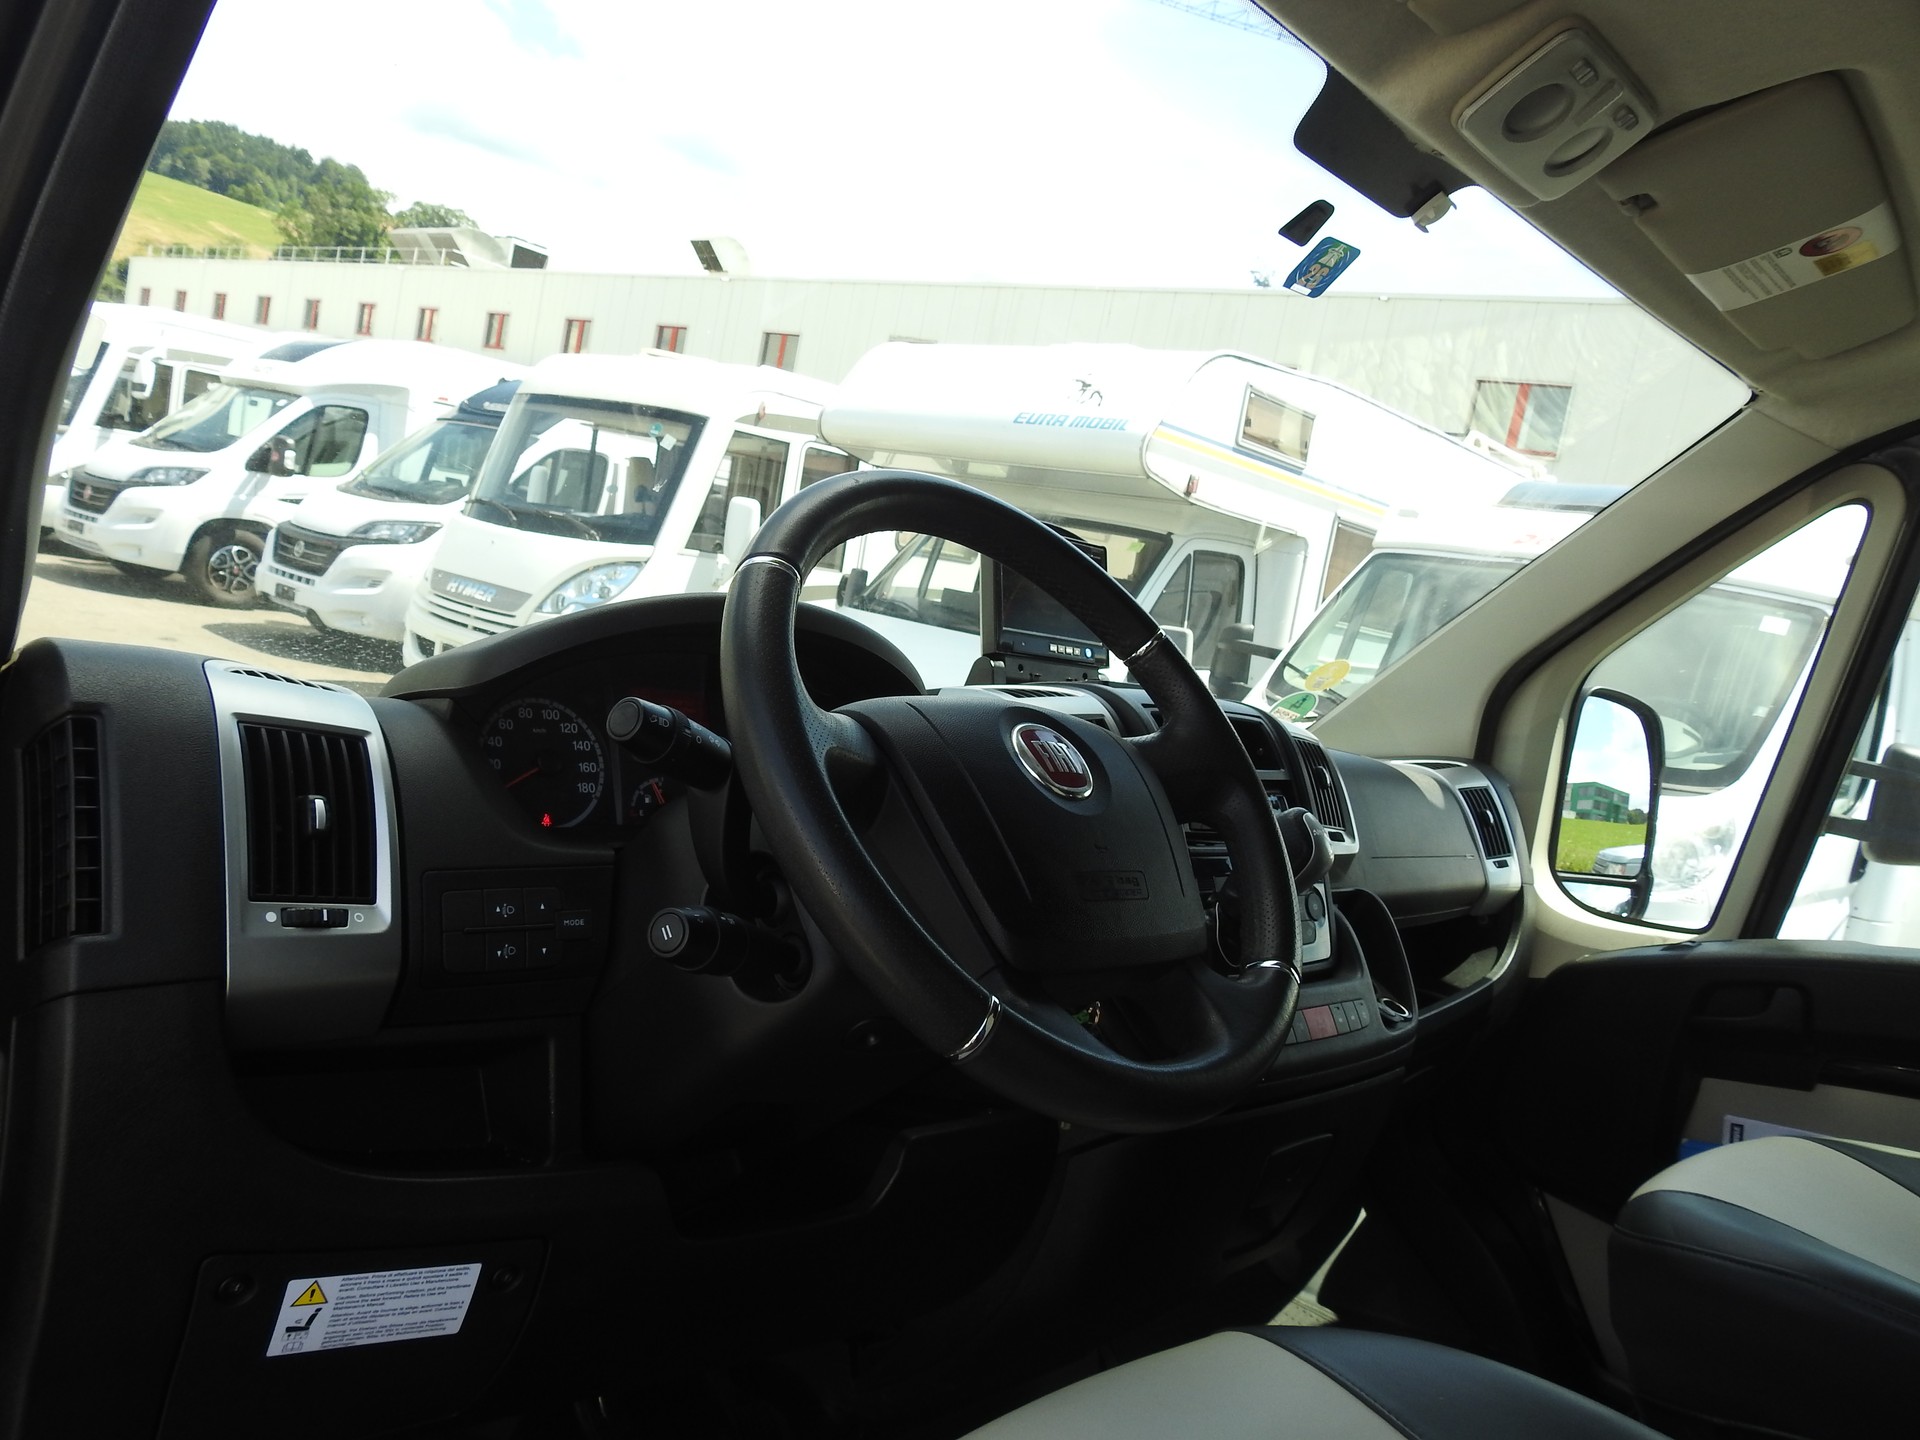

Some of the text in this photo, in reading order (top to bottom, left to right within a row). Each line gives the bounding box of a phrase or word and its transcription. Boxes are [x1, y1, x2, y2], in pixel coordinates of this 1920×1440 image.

[1012, 410, 1129, 432] EURA MOBIL
[446, 576, 498, 603] HYMER
[517, 706, 534, 720] 80
[541, 708, 561, 721] 100
[497, 717, 515, 731] 60
[559, 722, 579, 735] 120
[487, 735, 504, 748] 40
[571, 739, 592, 752] 140
[1030, 740, 1084, 775] FIAT
[578, 761, 598, 774] 160
[576, 781, 596, 795] 180
[562, 918, 586, 927] MODE
